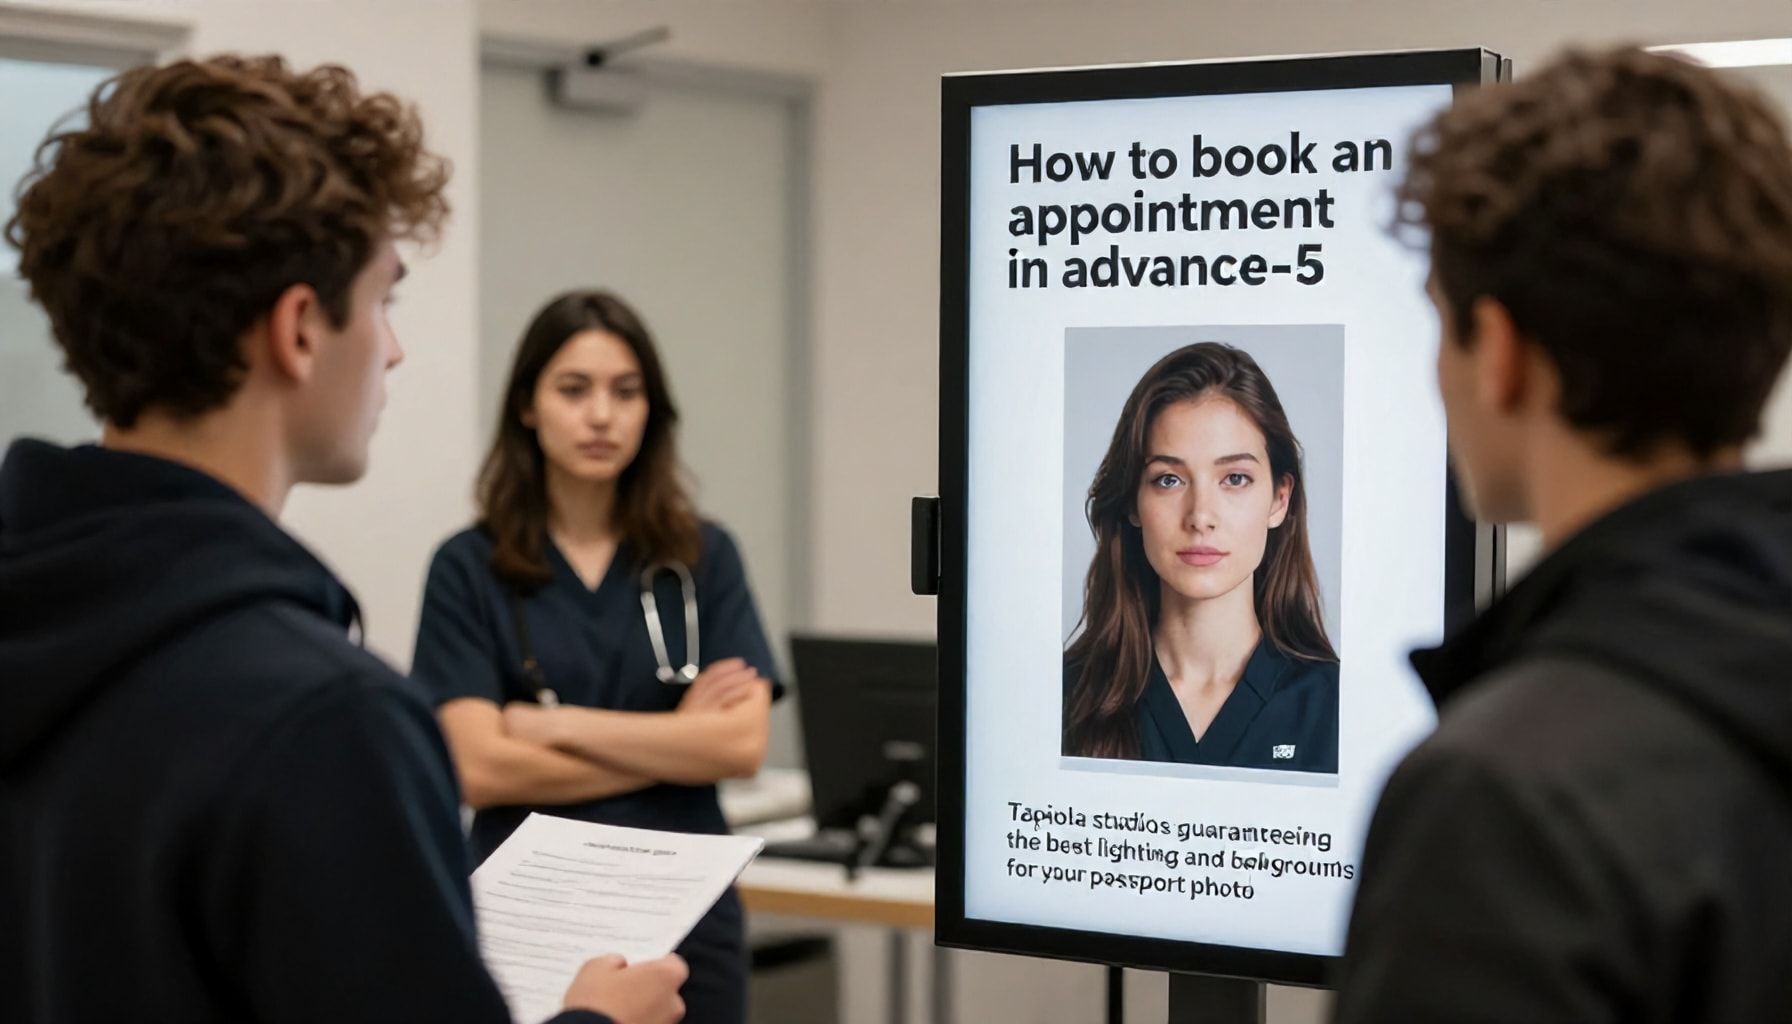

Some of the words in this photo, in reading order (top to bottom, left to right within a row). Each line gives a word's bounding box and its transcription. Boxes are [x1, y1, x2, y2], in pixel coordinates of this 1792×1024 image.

[1010, 142, 1115, 183] How
[1128, 141, 1178, 180] to
[1192, 131, 1319, 178] book
[1331, 138, 1393, 173] an
[1008, 188, 1335, 247] appointment
[1008, 247, 1049, 289] in
[1062, 243, 1325, 288] advance-5
[1007, 801, 1087, 831] Tapiola
[1006, 829, 1042, 850] the
[1046, 831, 1093, 857] best
[1184, 850, 1225, 868] and
[1006, 857, 1038, 878] for
[1041, 865, 1087, 885] your
[1090, 870, 1187, 896] passport
[1190, 876, 1255, 901] photo
